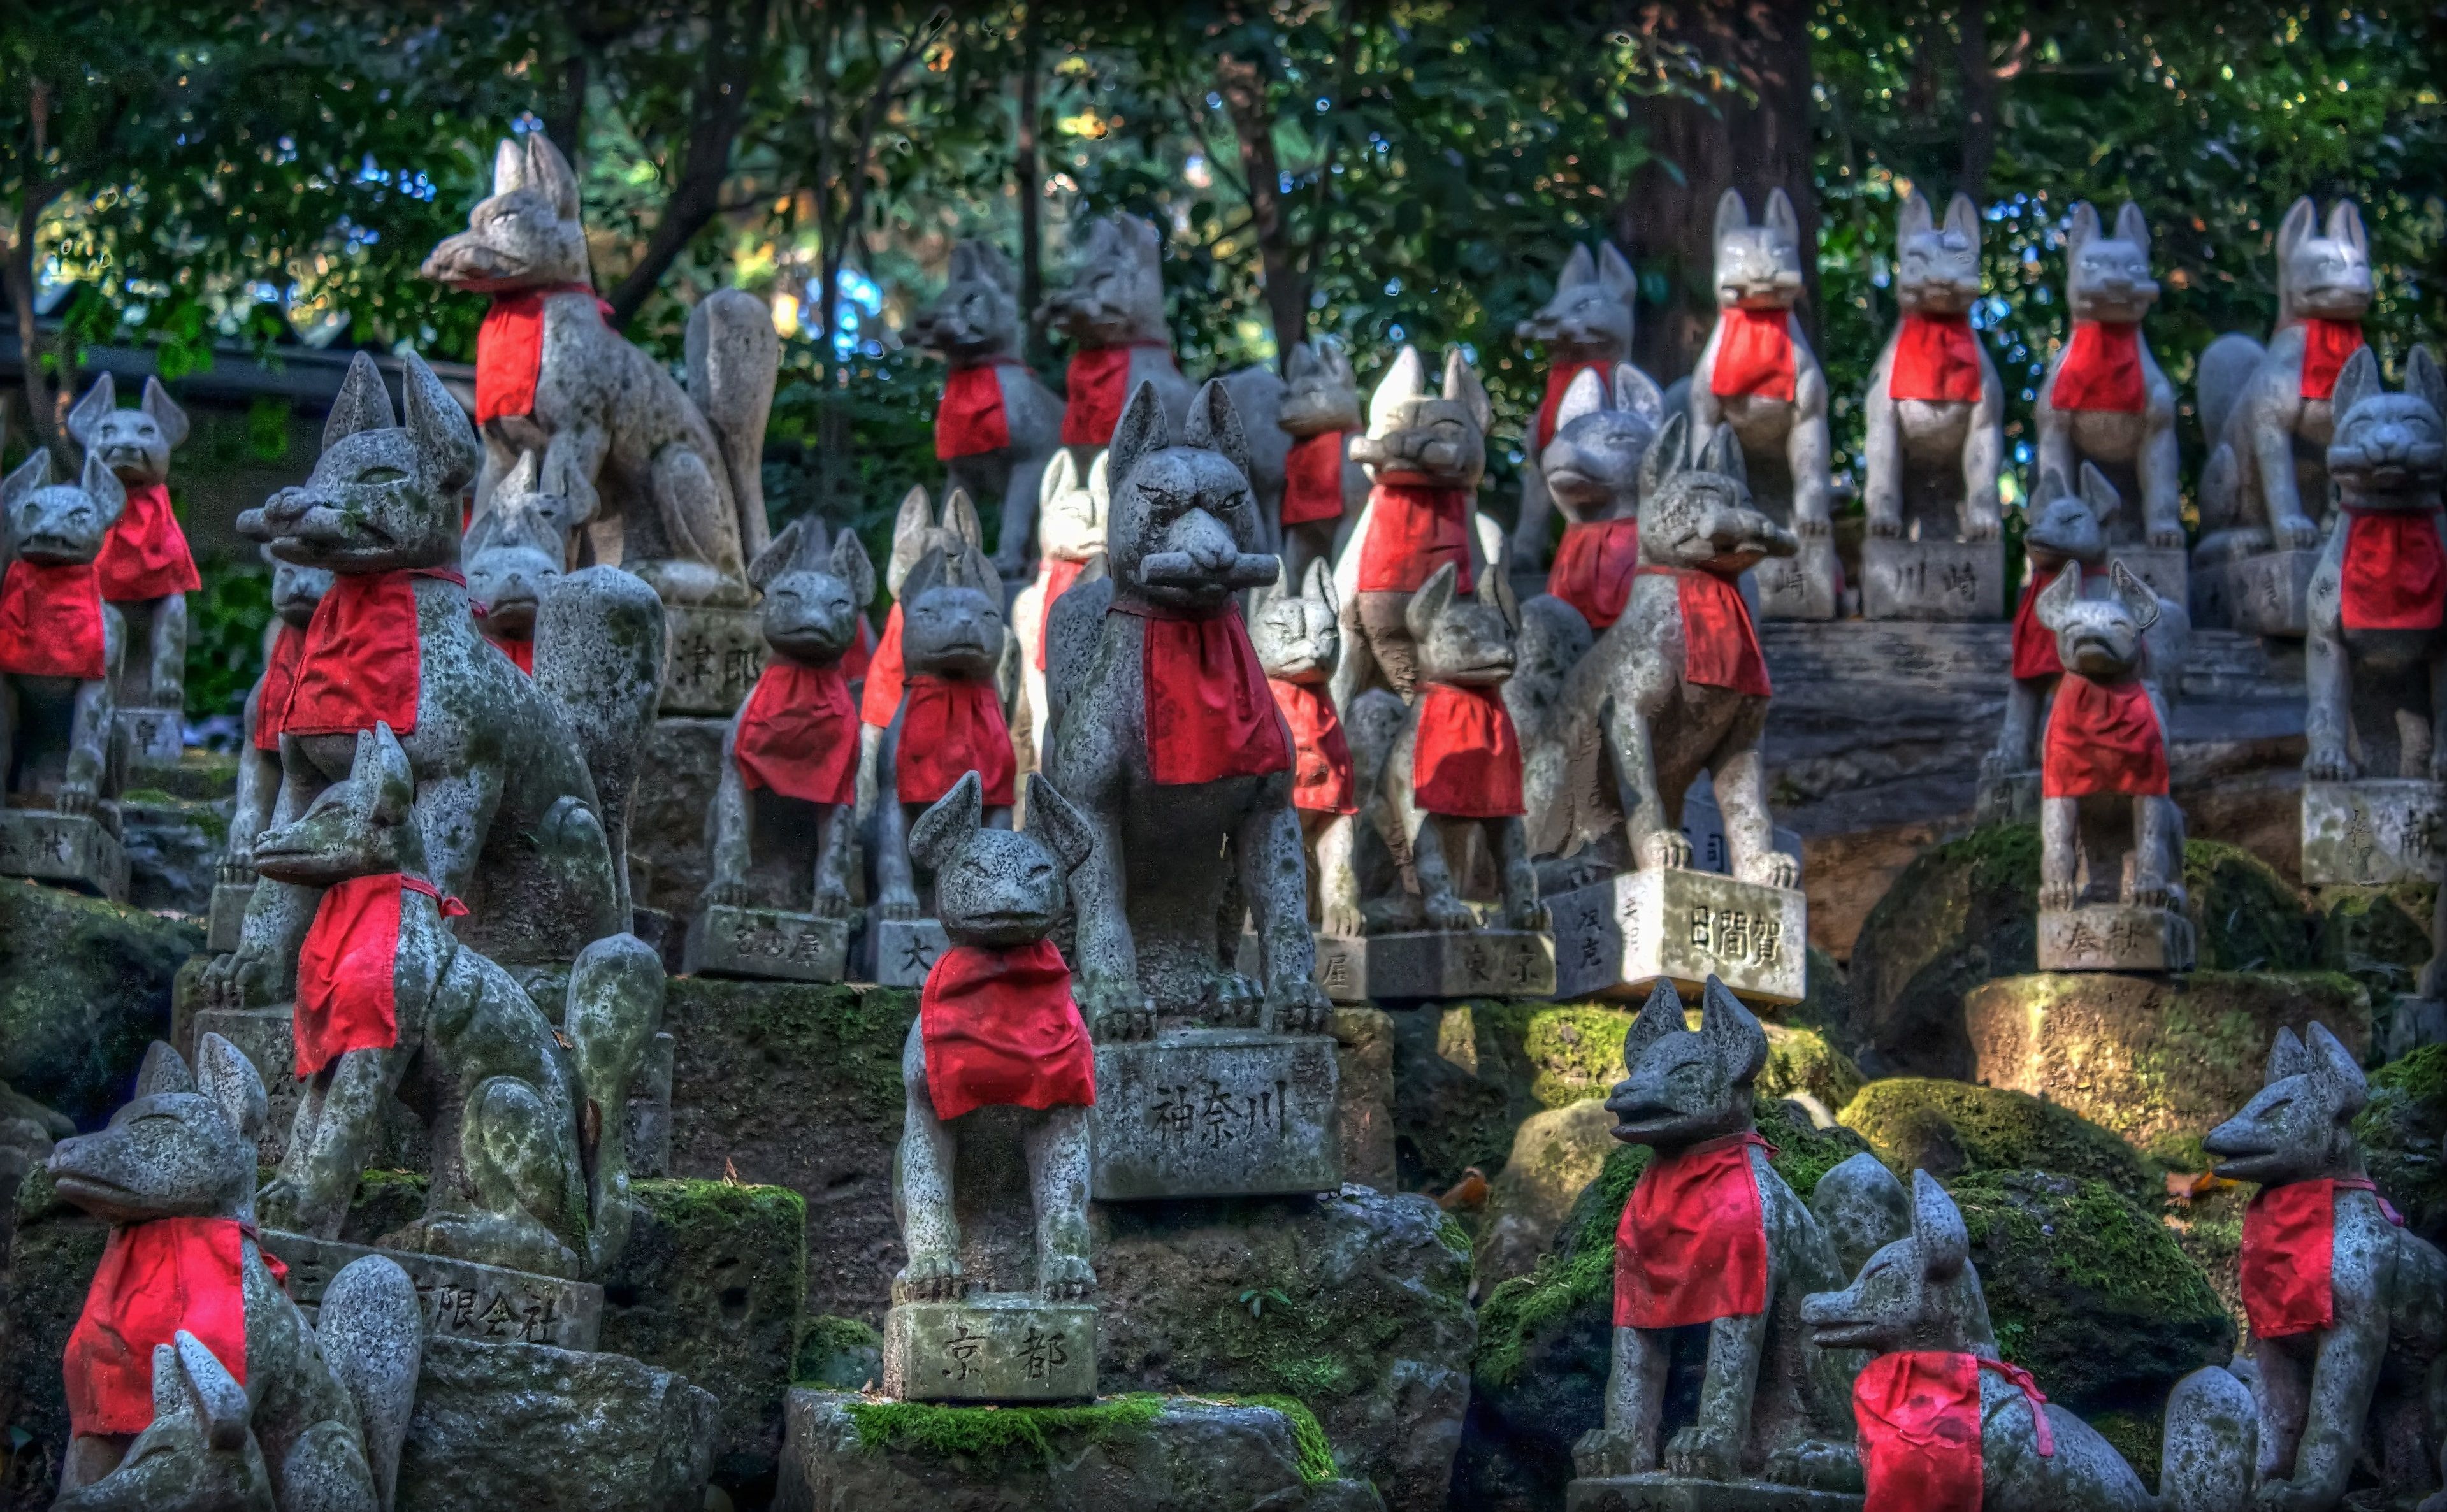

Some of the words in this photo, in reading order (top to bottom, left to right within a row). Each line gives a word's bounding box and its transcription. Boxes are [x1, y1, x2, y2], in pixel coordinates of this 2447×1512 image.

[1150, 1080, 1288, 1147] 神奈川
[941, 1325, 1068, 1381] 京都
